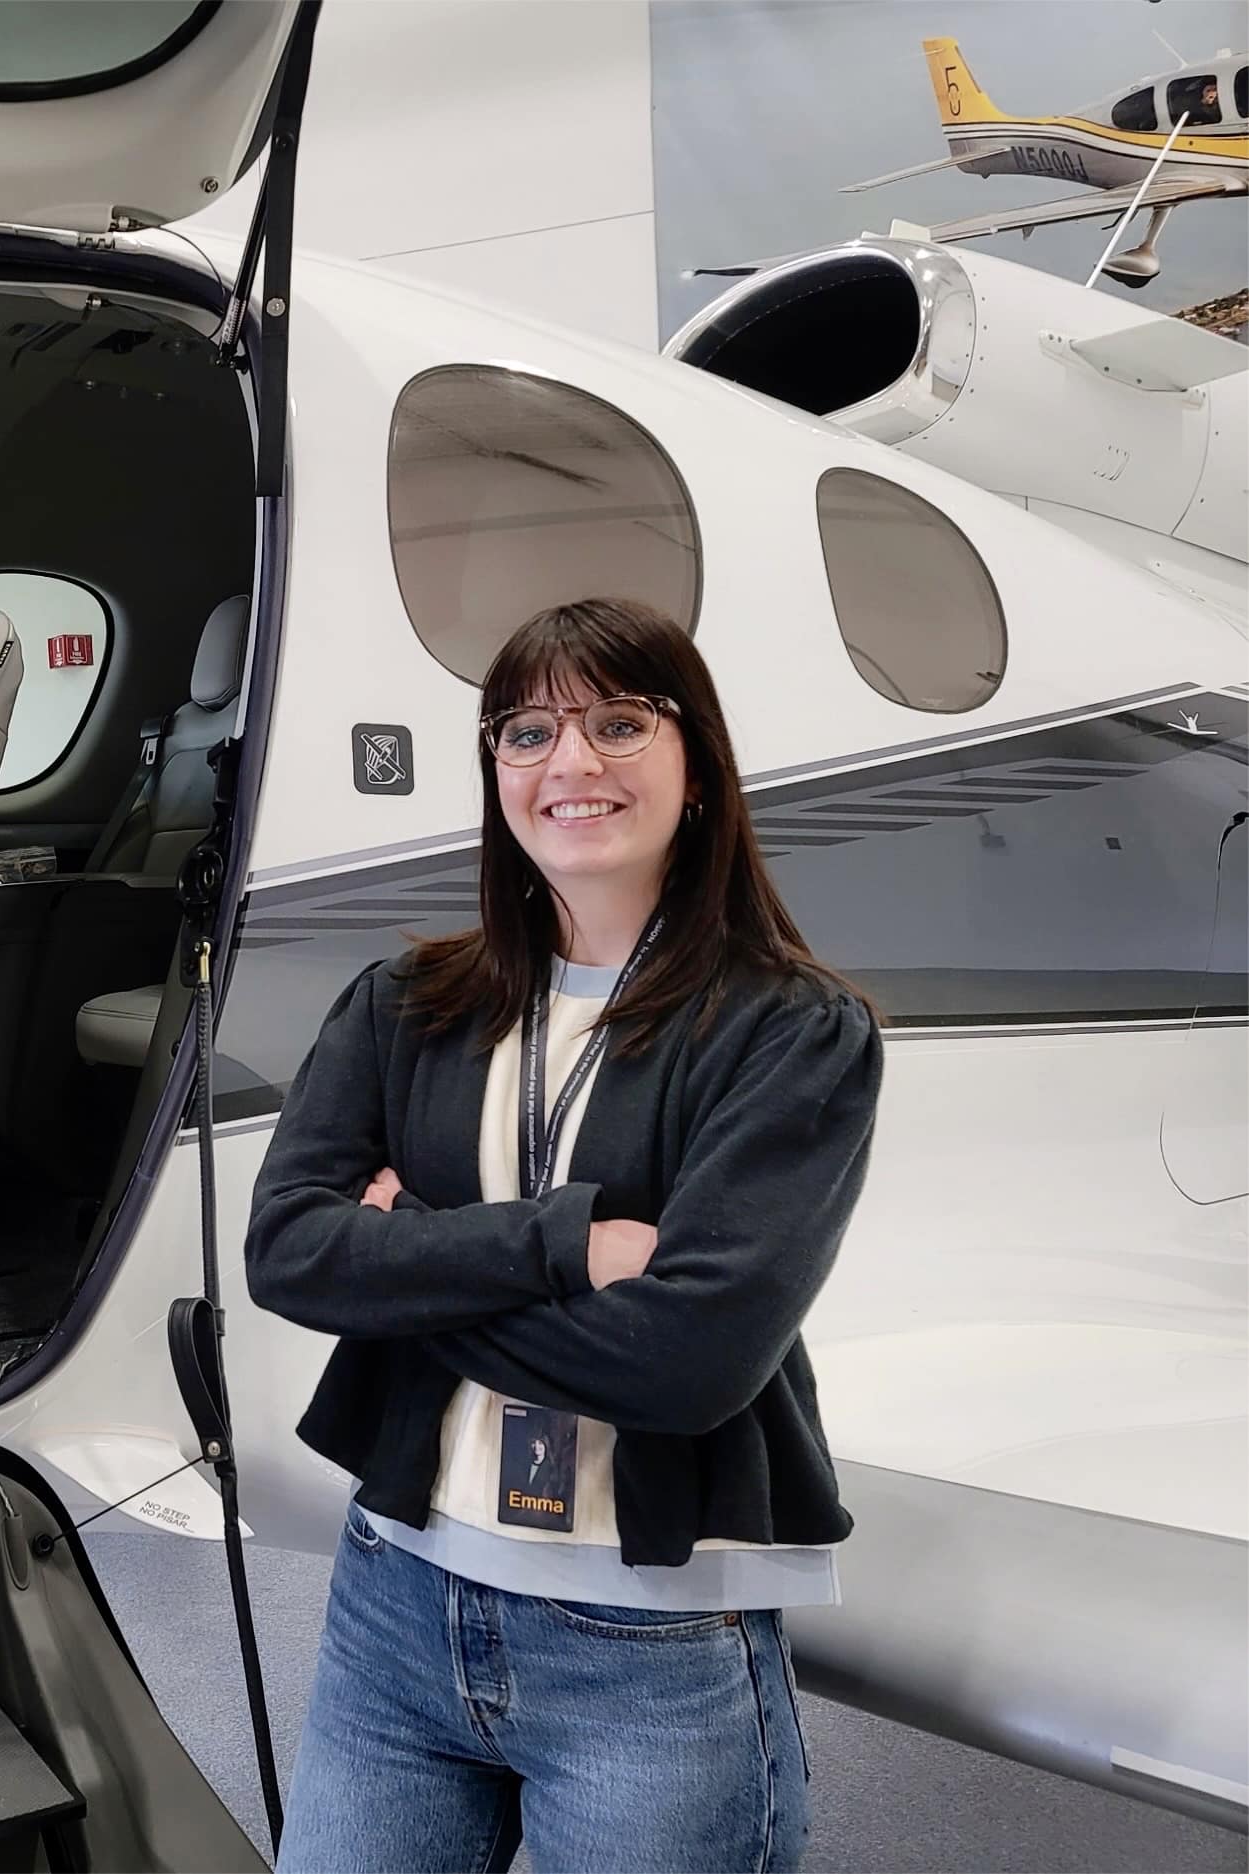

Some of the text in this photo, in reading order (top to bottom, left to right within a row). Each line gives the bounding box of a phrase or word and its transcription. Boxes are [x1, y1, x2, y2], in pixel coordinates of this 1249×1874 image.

[1011, 145, 1089, 182] N5000J
[144, 1500, 191, 1520] NO STEP
[509, 1490, 564, 1513] Emma
[139, 1506, 188, 1529] NO PISAR
